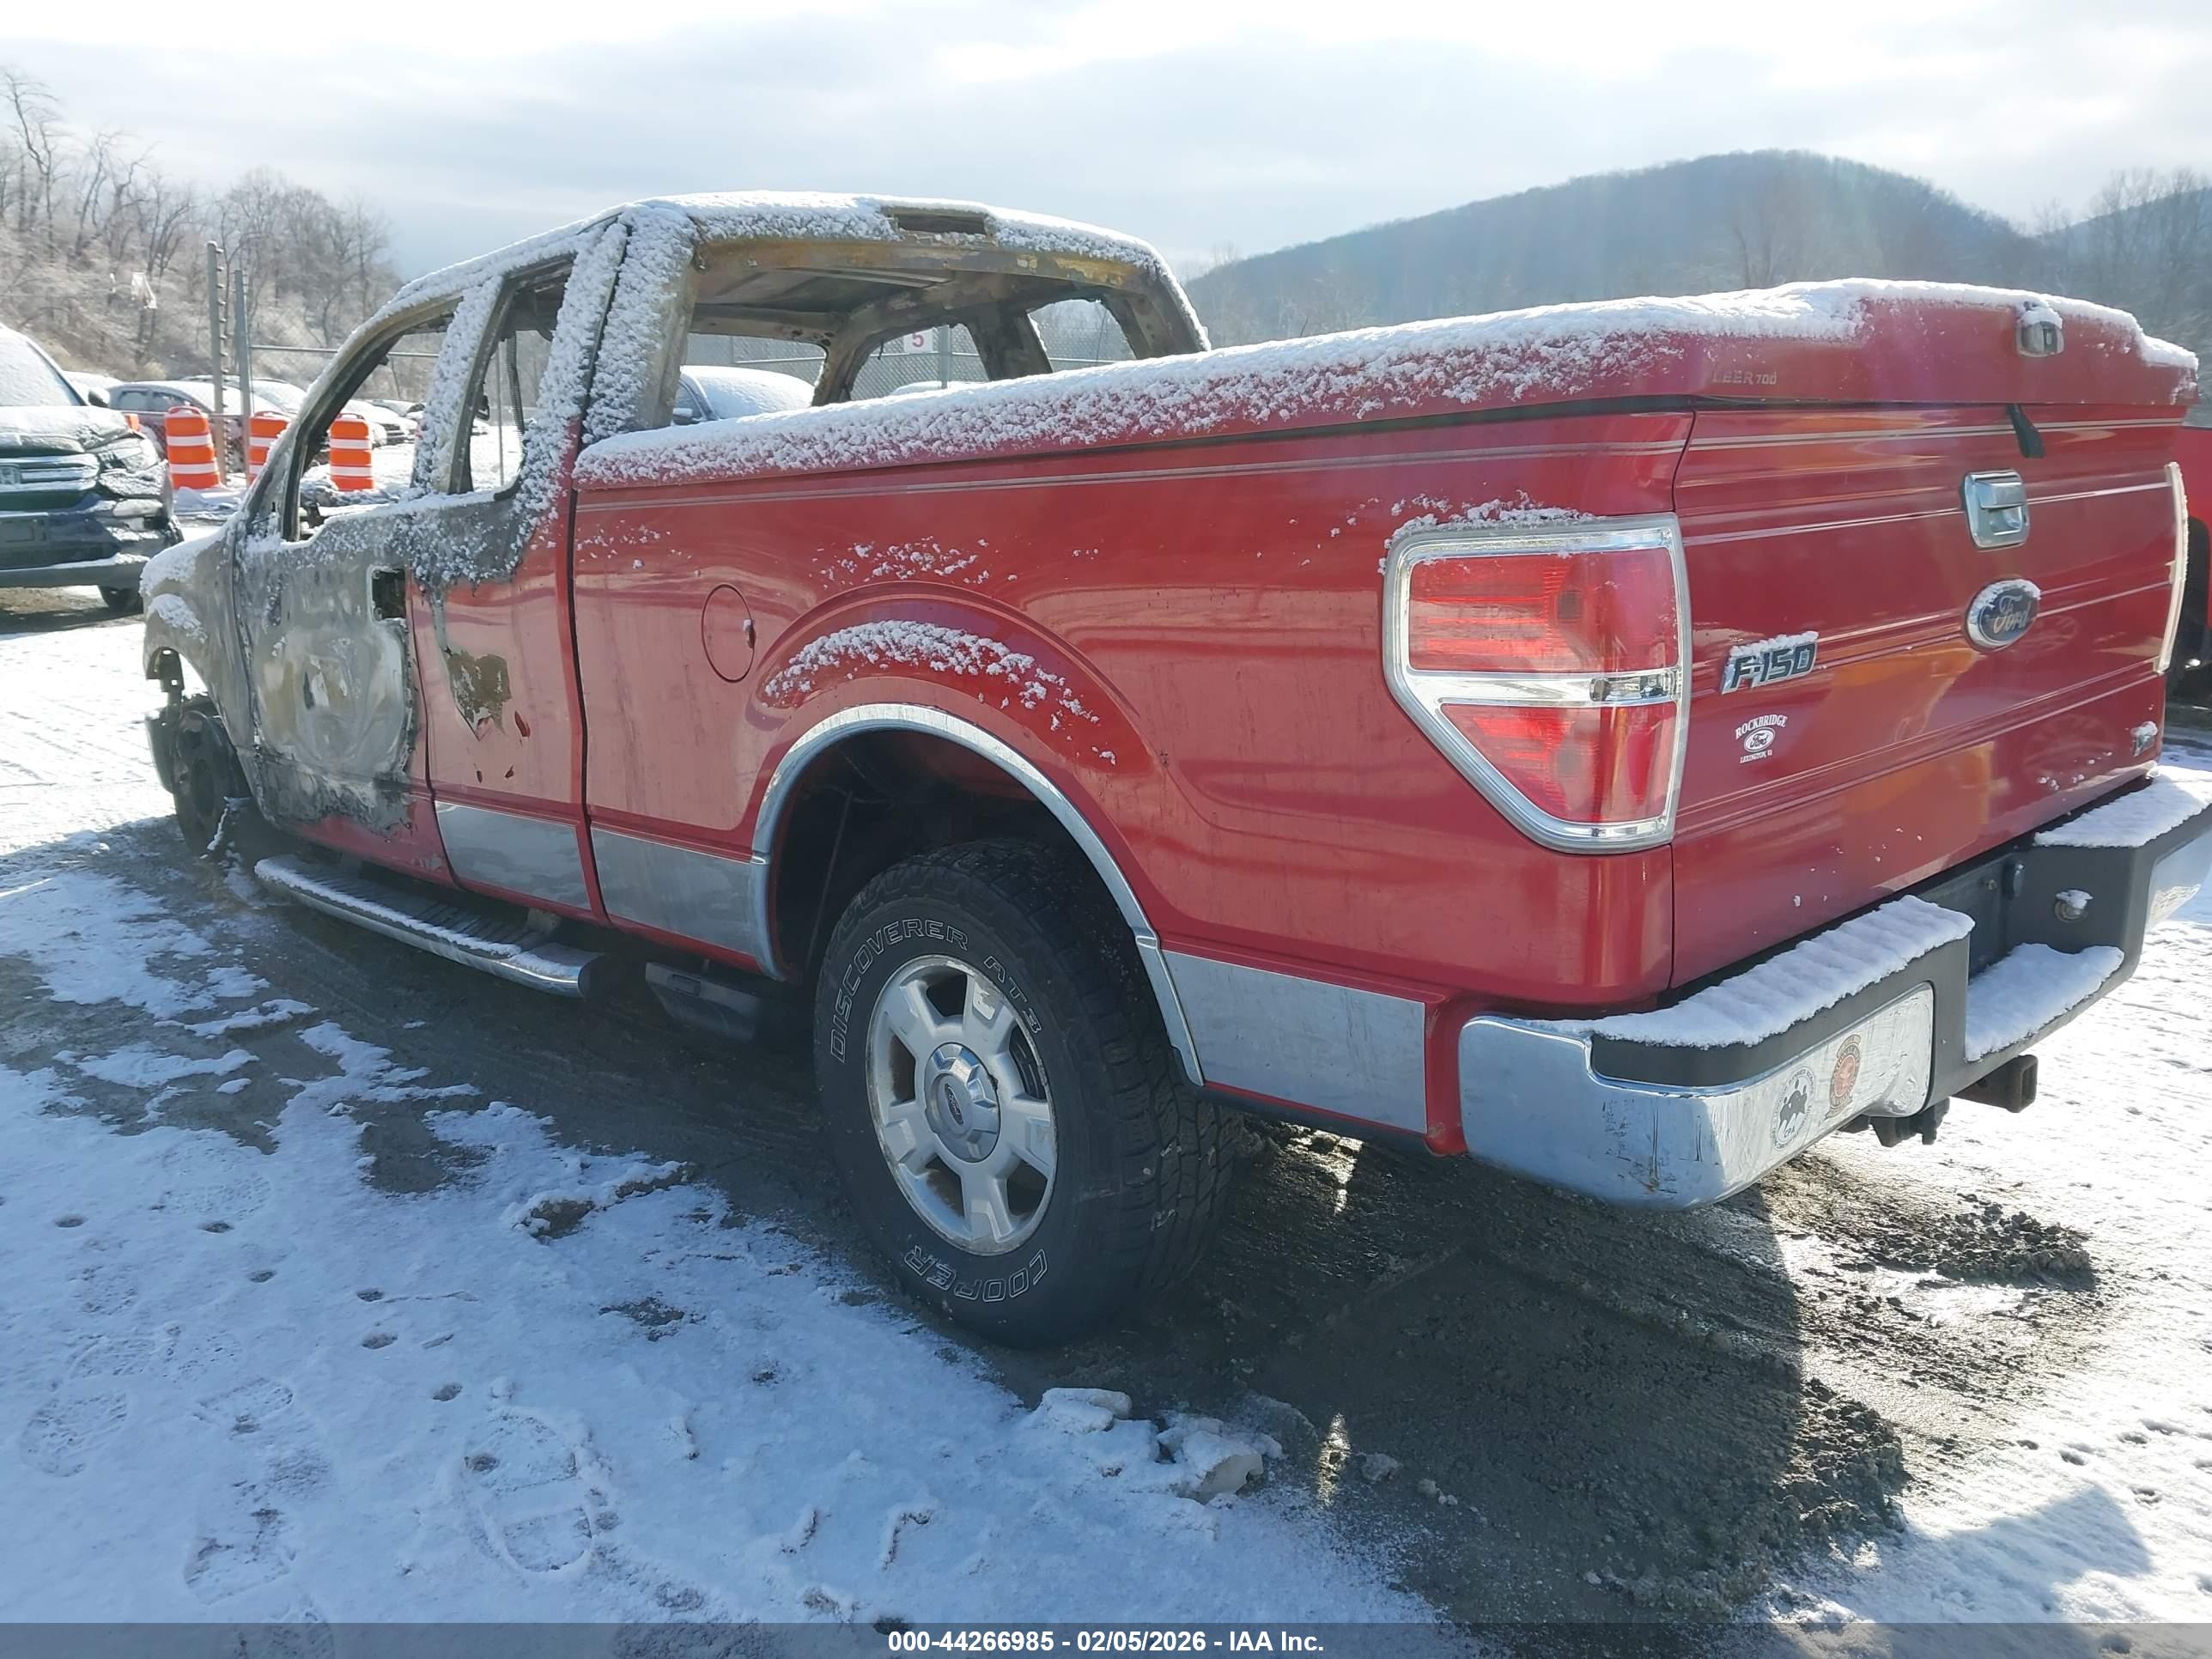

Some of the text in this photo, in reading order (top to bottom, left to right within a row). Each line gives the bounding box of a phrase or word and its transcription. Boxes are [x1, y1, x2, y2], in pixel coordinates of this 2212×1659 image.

[912, 333, 924, 348] 5
[1711, 370, 1753, 386] LEER
[1993, 594, 2032, 634] Ford
[1723, 641, 1817, 693] F-150
[1735, 714, 1788, 740] ROCKBRIDGE
[1749, 732, 1769, 748] Ford
[830, 918, 1043, 1065] DISCOVERER AT3
[904, 1245, 1048, 1303] COOPER
